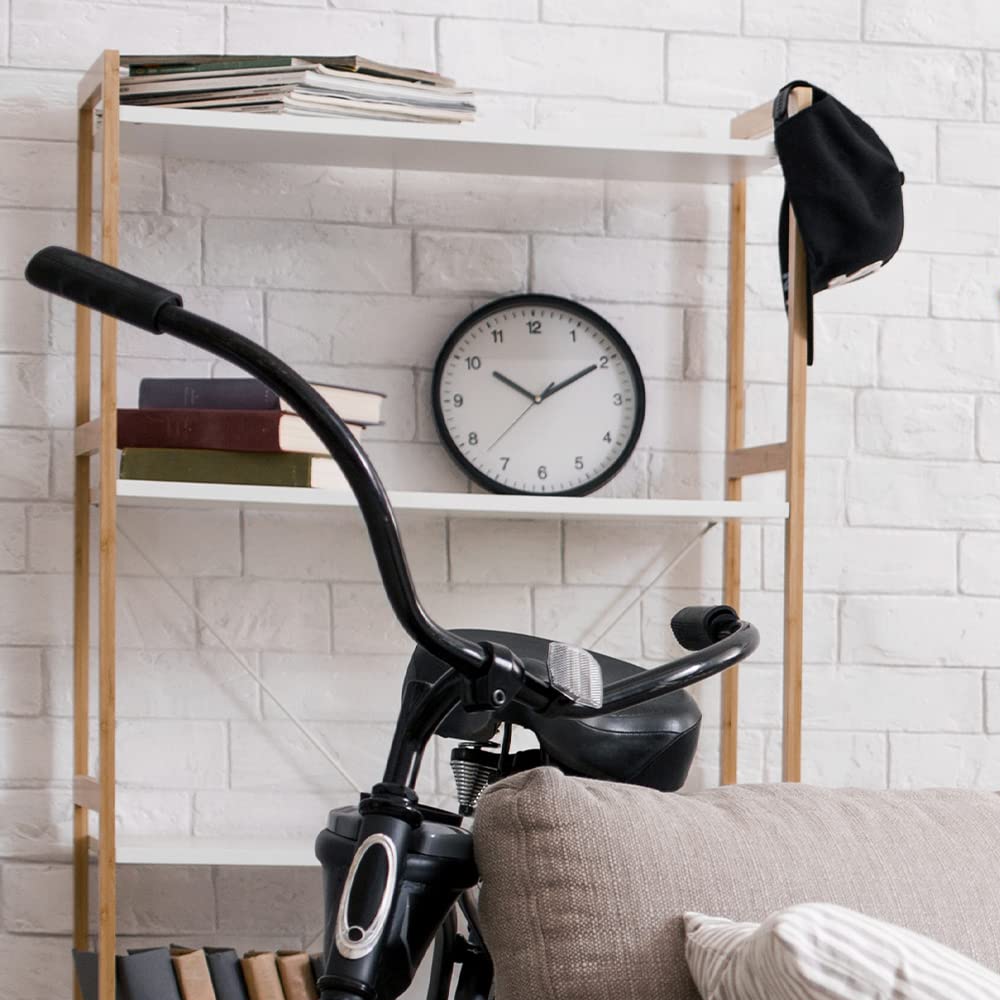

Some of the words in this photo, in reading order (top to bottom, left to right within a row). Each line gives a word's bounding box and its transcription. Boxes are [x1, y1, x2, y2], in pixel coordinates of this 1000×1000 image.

[526, 320, 541, 334] 12
[491, 329, 503, 343] 11
[570, 330, 576, 342] 1
[465, 355, 481, 369] 10
[599, 356, 609, 369] 2
[453, 394, 463, 407] 9
[613, 393, 622, 406] 3
[468, 432, 478, 445] 8
[603, 432, 612, 443] 4
[500, 457, 510, 471] 7
[574, 456, 583, 470] 5
[537, 466, 547, 480] 6
